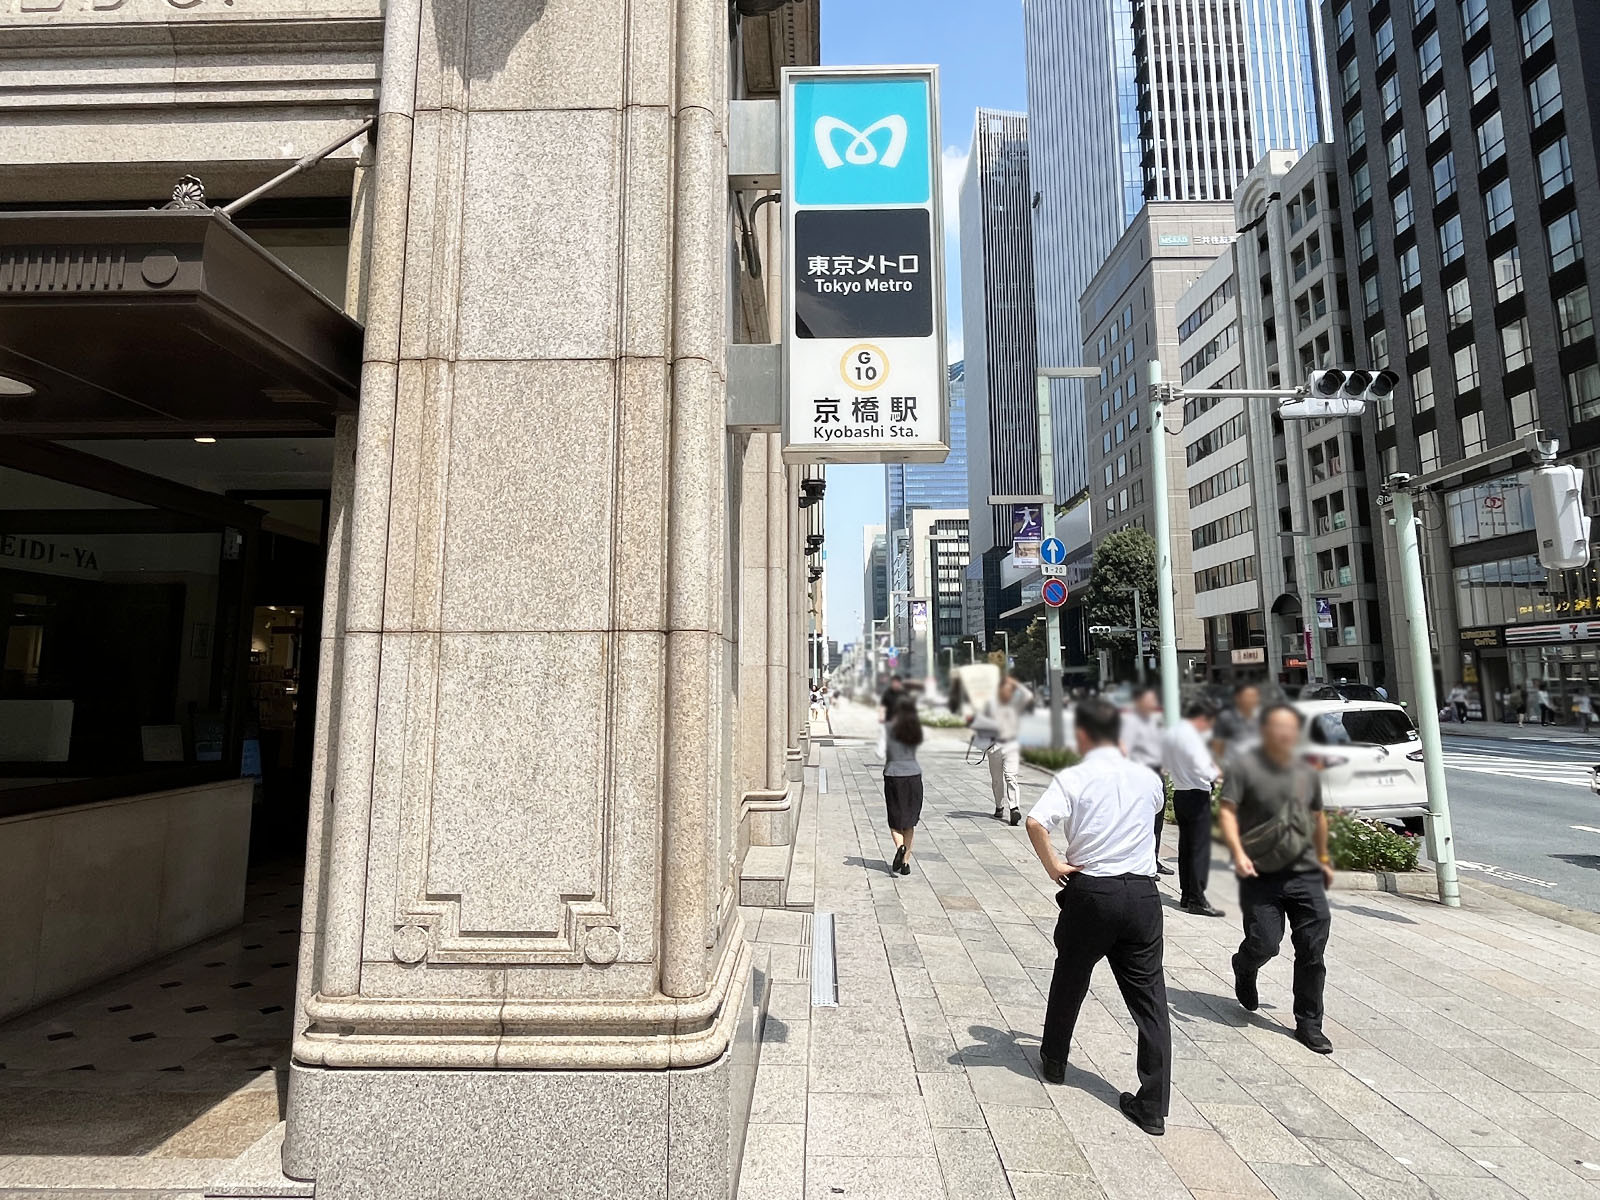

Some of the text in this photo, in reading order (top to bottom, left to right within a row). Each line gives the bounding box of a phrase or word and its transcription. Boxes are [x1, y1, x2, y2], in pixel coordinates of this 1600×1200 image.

[807, 254, 919, 277] 東京メトロ
[814, 278, 913, 296] Tokyo Metro
[857, 351, 871, 366] G
[854, 366, 877, 382] 10
[813, 396, 918, 424] 京橋駅
[813, 423, 919, 442] Kyobashi Sta.
